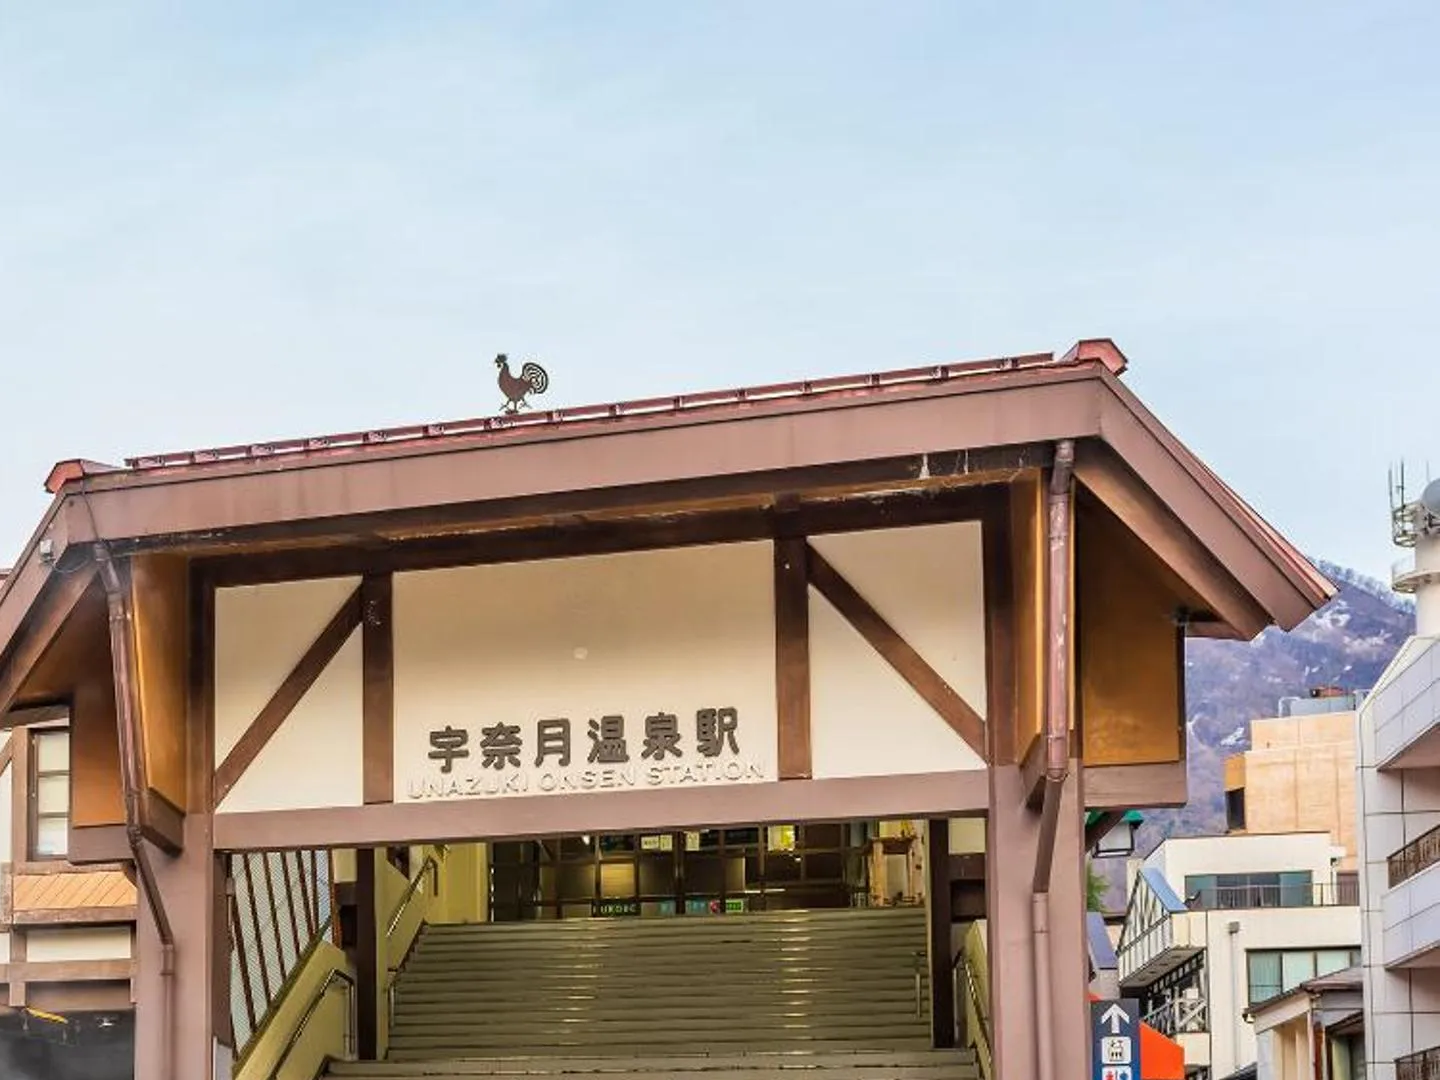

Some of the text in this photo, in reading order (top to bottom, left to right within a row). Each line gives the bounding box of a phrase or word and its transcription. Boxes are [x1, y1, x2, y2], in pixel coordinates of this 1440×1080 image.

[427, 706, 741, 774] 宇奈月温泉駅
[540, 764, 637, 794] ONSEN
[645, 758, 766, 788] STATION
